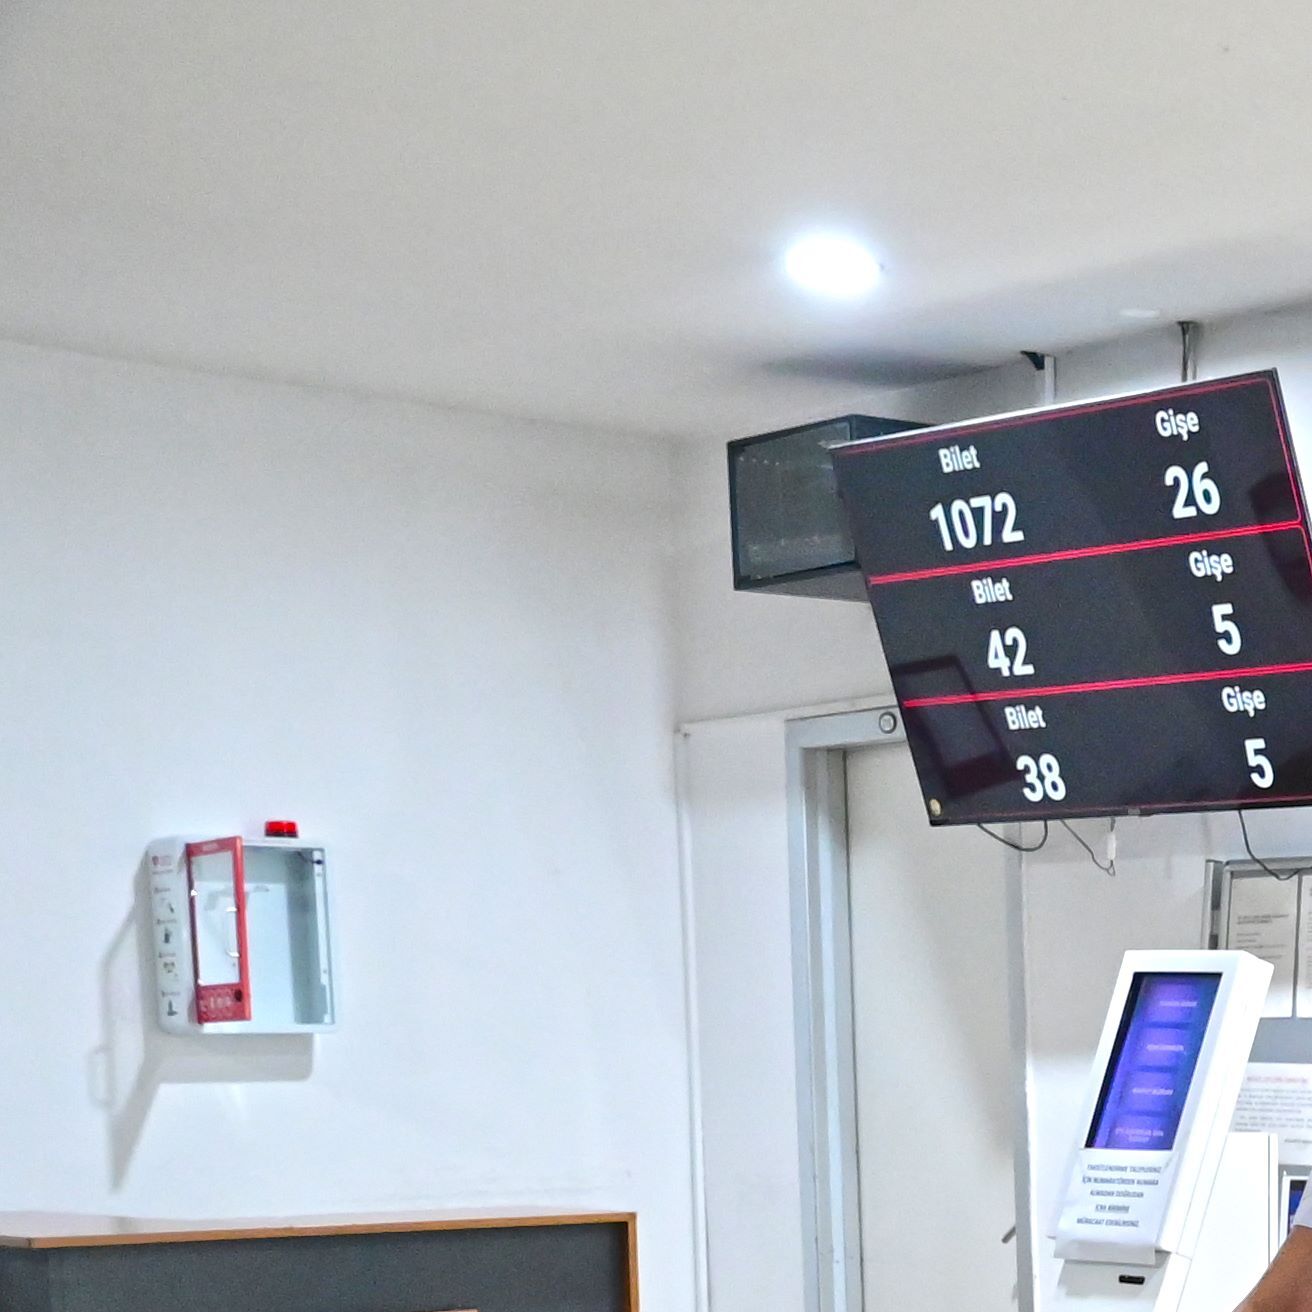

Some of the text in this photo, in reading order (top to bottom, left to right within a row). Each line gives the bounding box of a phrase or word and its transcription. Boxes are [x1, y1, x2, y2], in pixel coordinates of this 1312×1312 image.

[1155, 408, 1200, 442] Gişe
[938, 444, 981, 474] Bilet
[1164, 461, 1221, 519] 26
[929, 491, 1025, 552] 1072
[1188, 549, 1234, 582] Gişe
[970, 576, 1014, 605] Bilet
[1211, 602, 1242, 656] 5
[987, 626, 1035, 677] 42
[1003, 704, 1047, 731] Bilet
[1221, 685, 1266, 718] Gişe
[1016, 752, 1067, 802] 38
[1244, 737, 1274, 789] 5
